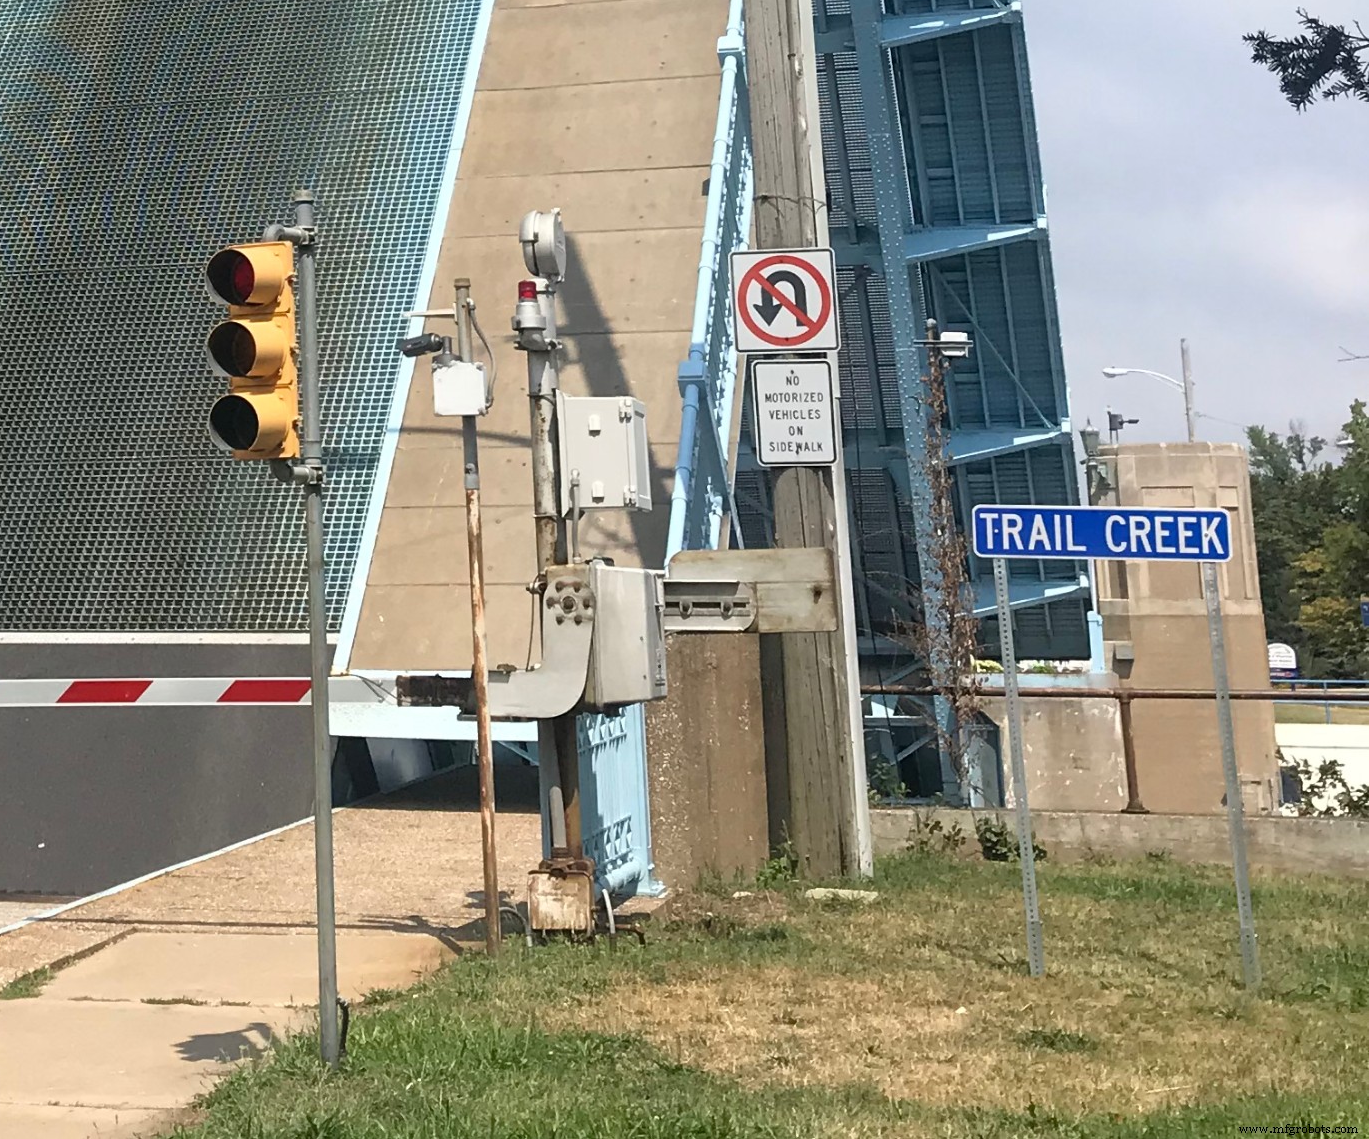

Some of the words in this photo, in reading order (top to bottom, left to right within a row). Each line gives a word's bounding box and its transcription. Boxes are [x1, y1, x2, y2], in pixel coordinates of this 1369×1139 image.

[785, 376, 800, 386] NO
[764, 392, 824, 403] MOTORIZED
[769, 409, 821, 420] VEHICLES
[788, 426, 803, 436] ON
[769, 441, 823, 452] SIDEWALK
[979, 513, 1087, 551] TRAIL
[1105, 514, 1224, 554] CREEK
